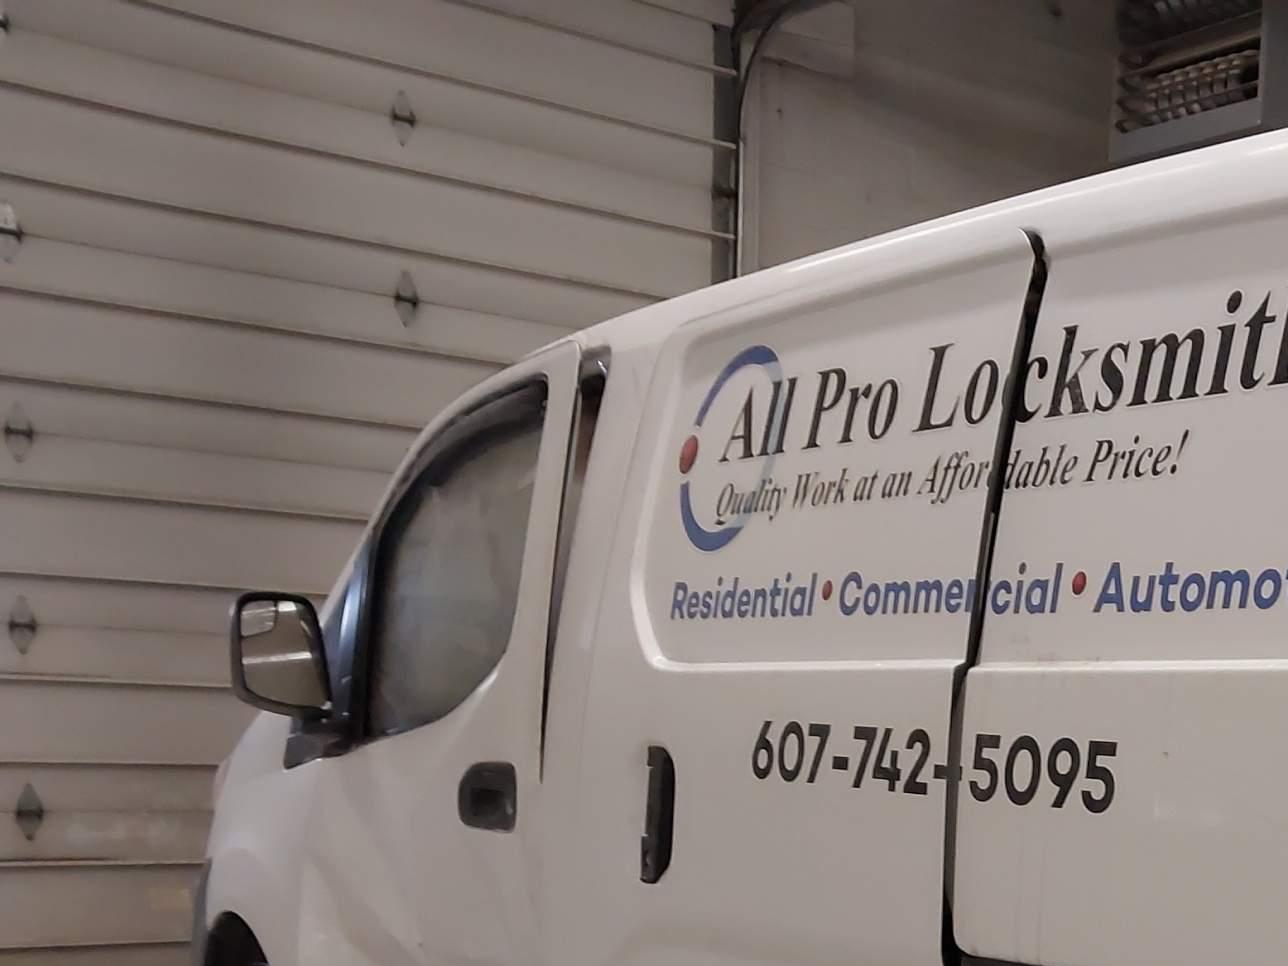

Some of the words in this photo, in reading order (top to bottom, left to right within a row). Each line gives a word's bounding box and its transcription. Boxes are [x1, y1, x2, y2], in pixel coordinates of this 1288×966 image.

[719, 376, 795, 464] All
[802, 368, 897, 451] Pro
[715, 478, 788, 525] Quality
[791, 471, 850, 510] Work
[854, 473, 879, 503] at
[882, 471, 913, 499] an
[1085, 430, 1190, 482] Price!
[670, 573, 814, 621] Residential
[838, 562, 1063, 618] Commercial
[751, 720, 1118, 814] 607-742-5095
